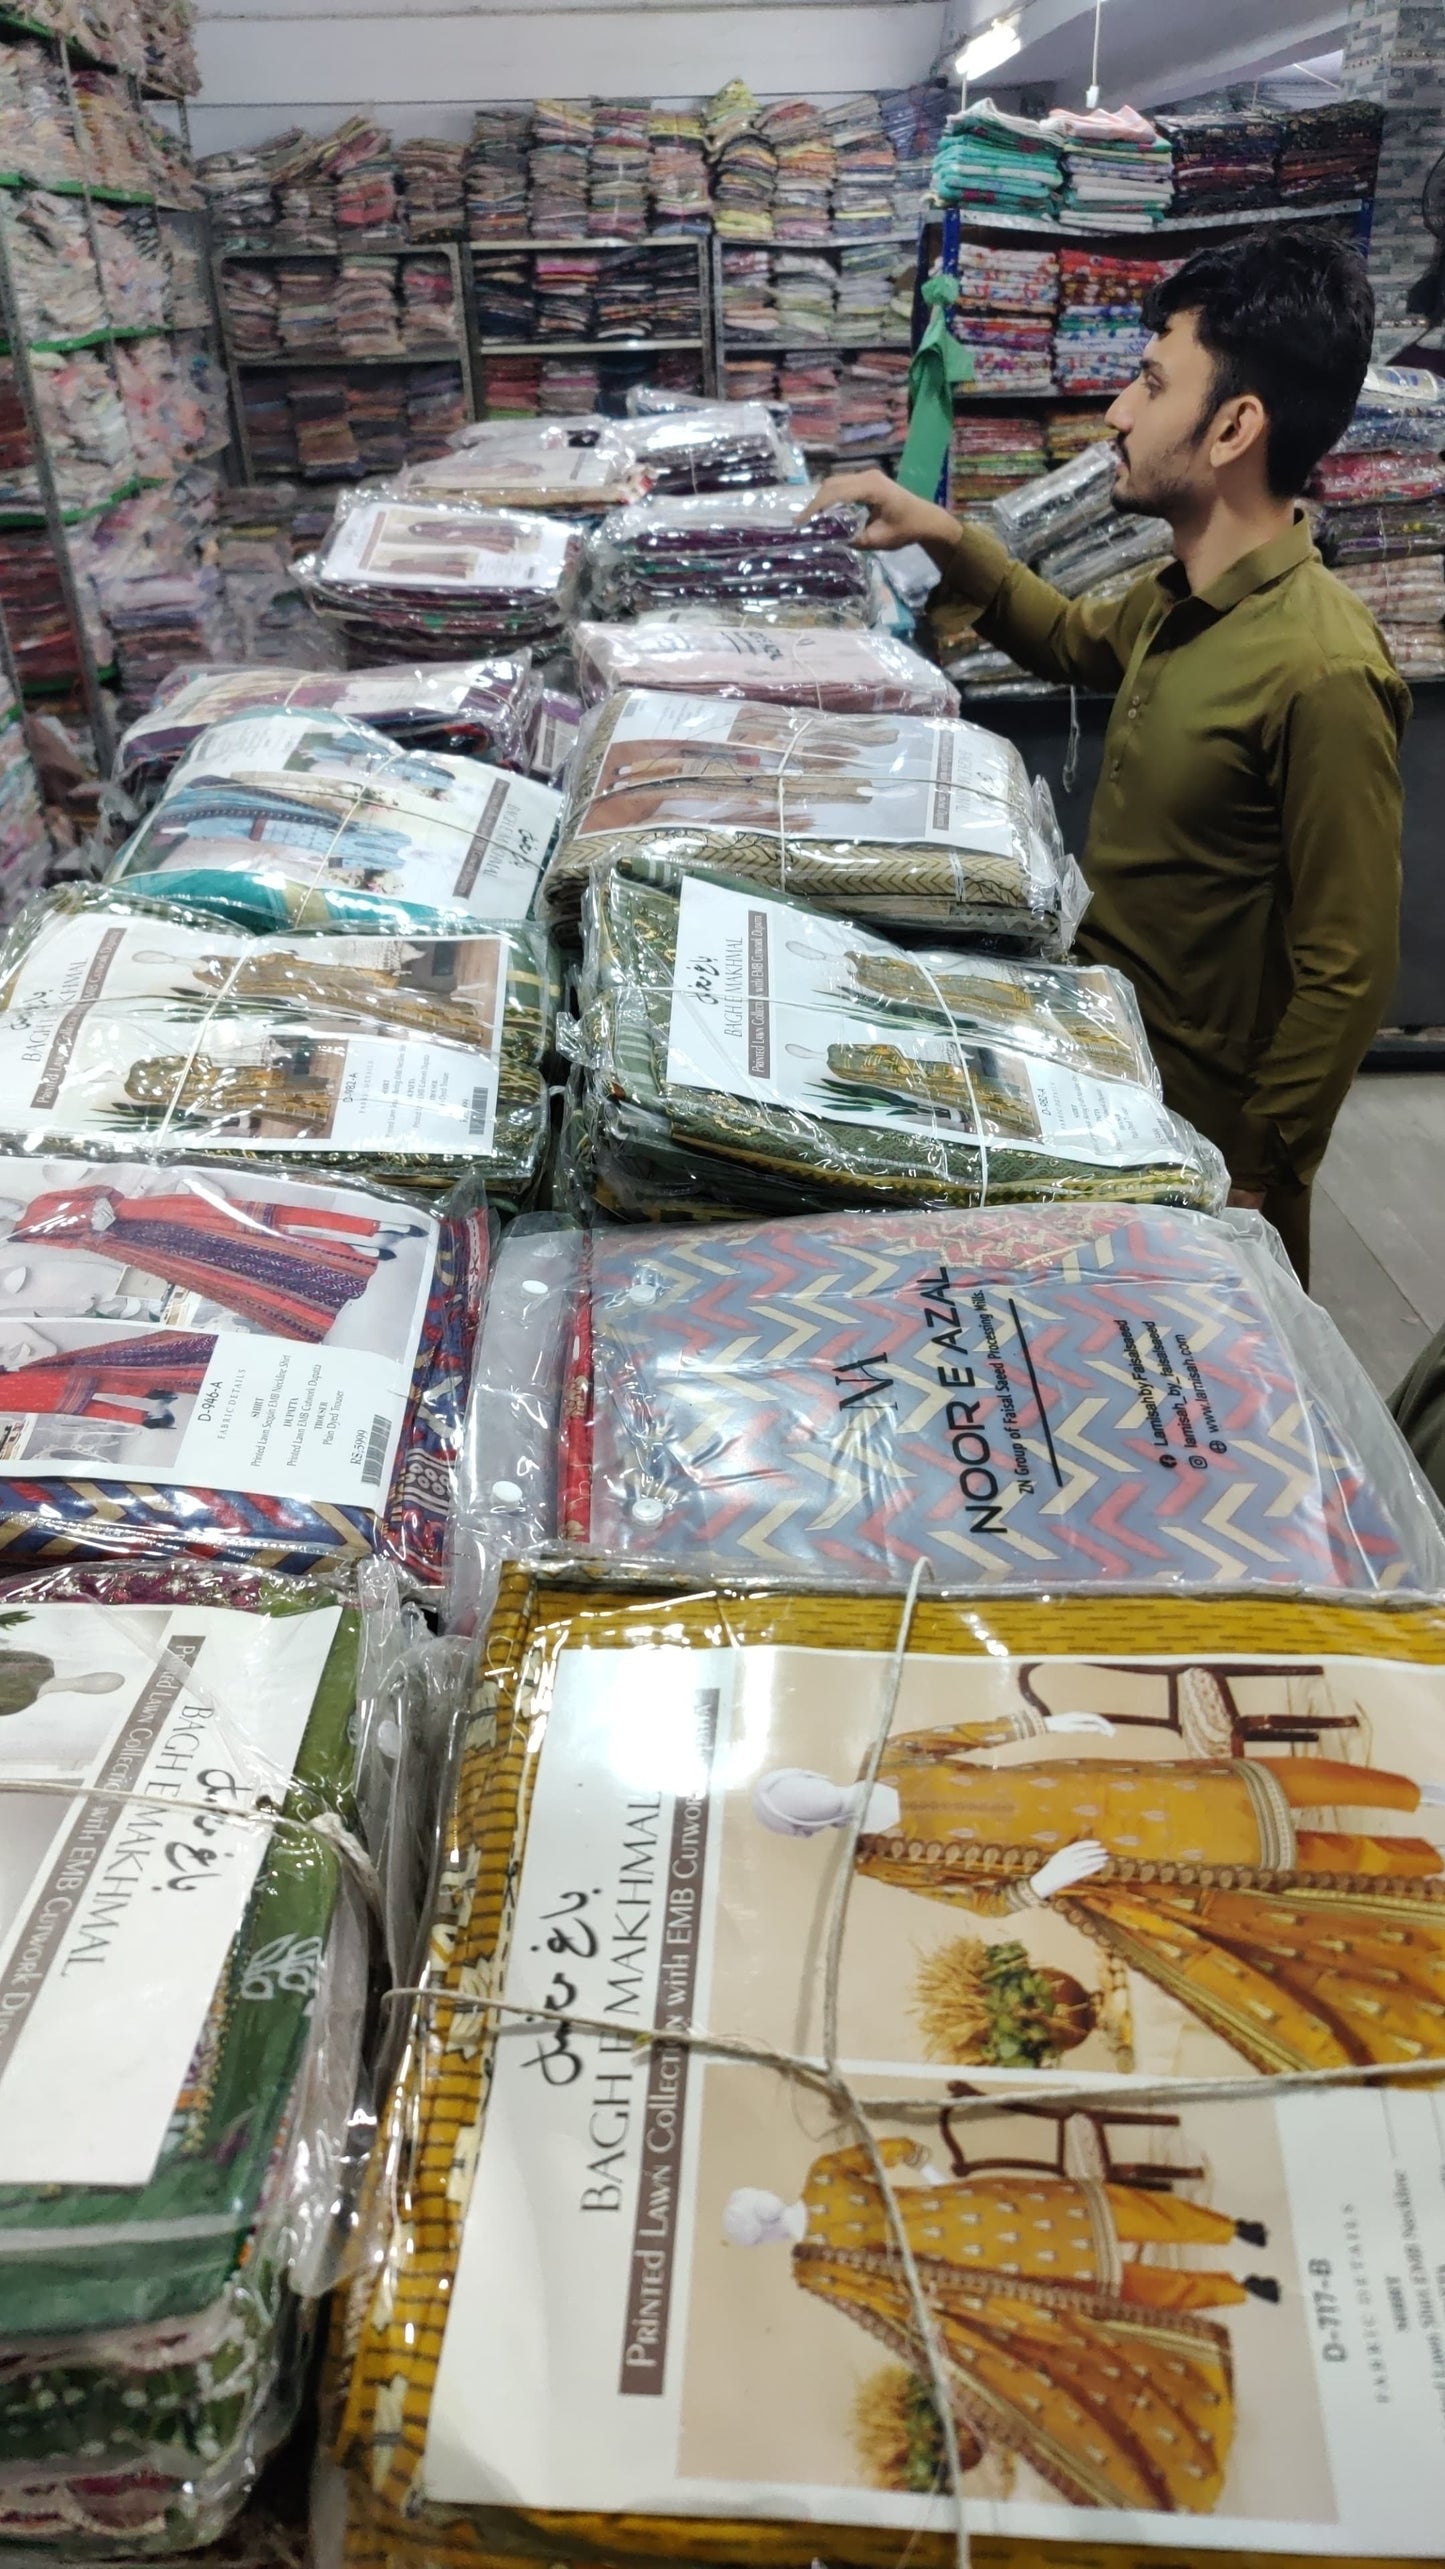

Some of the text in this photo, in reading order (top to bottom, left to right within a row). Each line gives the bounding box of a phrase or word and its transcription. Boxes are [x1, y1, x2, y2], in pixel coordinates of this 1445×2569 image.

[723, 1002, 743, 1037] BAGH
[198, 1381, 223, 1422] D-946-A
[217, 1368, 246, 1440] FABRIC DETAILS
[252, 1397, 265, 1418] SHIRT
[916, 1267, 1008, 1534] NOOR E AZAL
[973, 1290, 1035, 1495] ZN Group of Faisal Saeed Processing Mills.
[1175, 1333, 1219, 1434] www.lamisah.com
[257, 1429, 270, 1444] Lawn
[293, 1428, 305, 1443] Lawn
[297, 1412, 309, 1427] EMB
[322, 1390, 344, 1445] Plain Dyed Trouser
[250, 1445, 266, 1467] Printed
[287, 1444, 301, 1467] Printed
[138, 1688, 172, 1724] Lawn
[155, 1703, 214, 1772] BAGH
[78, 1805, 110, 1843] with
[55, 1845, 98, 1892] EMB
[60, 1806, 169, 1978] MAKHMAL
[603, 1790, 663, 2016] MAKHMAL
[666, 1887, 696, 1945] EMB
[10, 1896, 74, 1986] Cutwork
[662, 1953, 691, 2007] with
[578, 2073, 635, 2213] BAGH
[638, 2163, 672, 2238] Lawn
[625, 2249, 667, 2368] Printed
[1308, 2258, 1348, 2362] D-717-B
